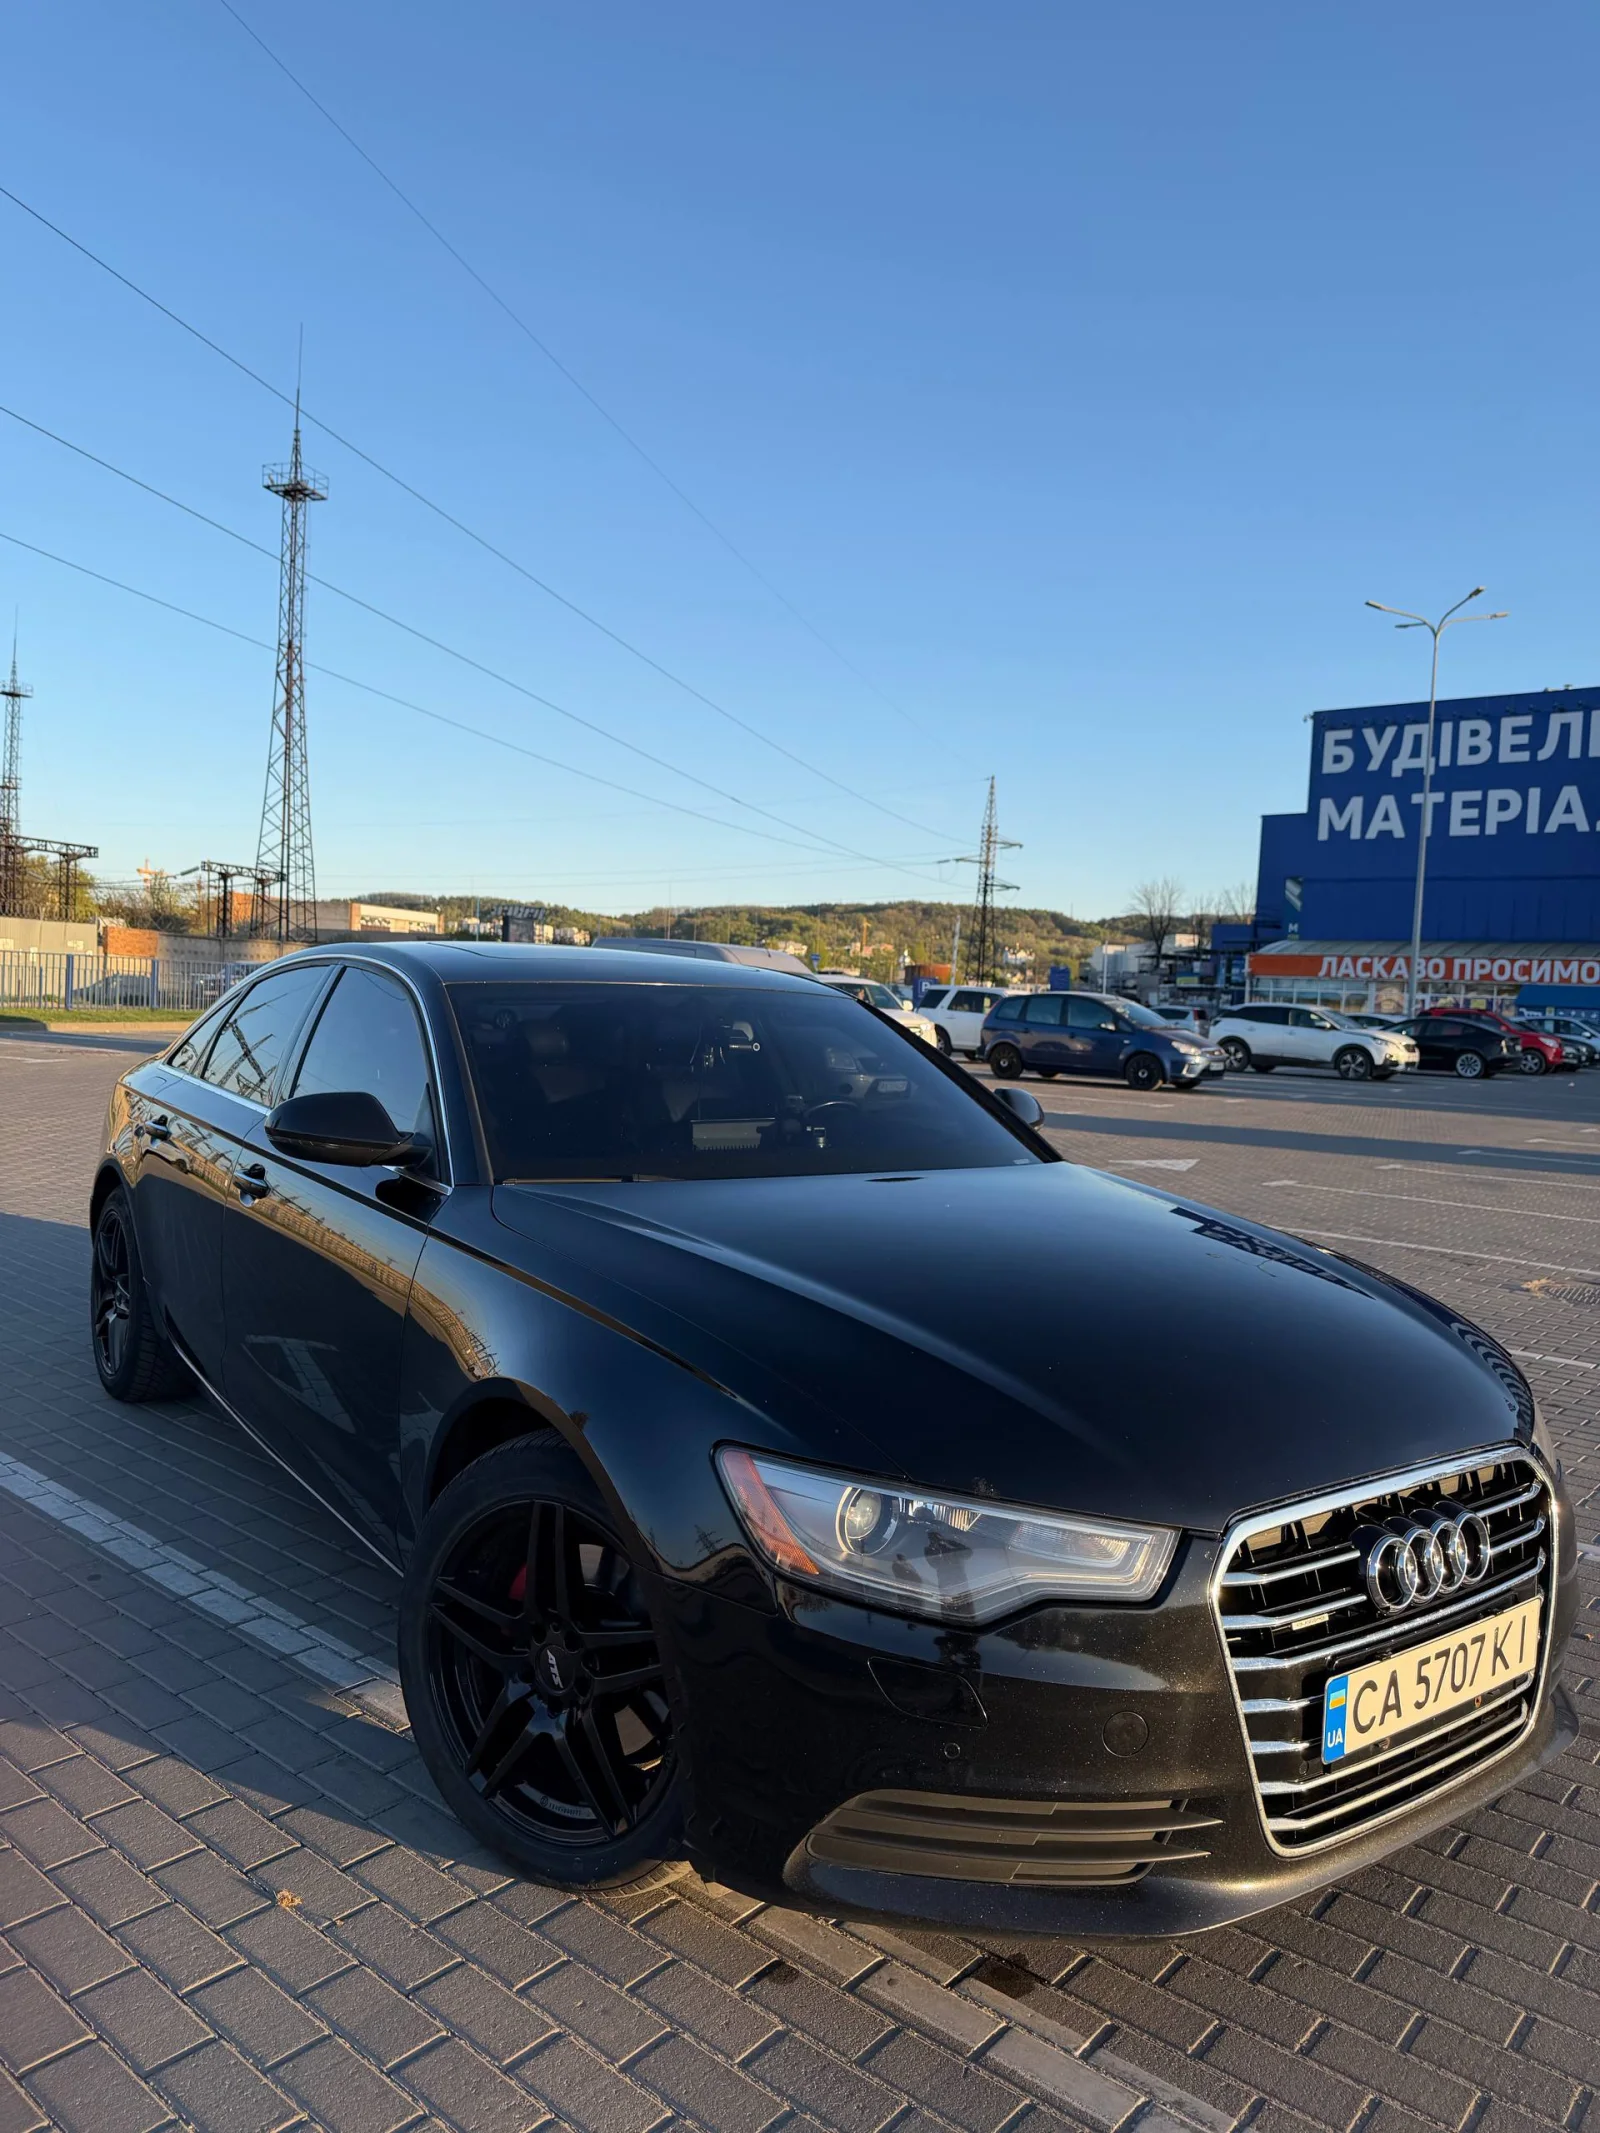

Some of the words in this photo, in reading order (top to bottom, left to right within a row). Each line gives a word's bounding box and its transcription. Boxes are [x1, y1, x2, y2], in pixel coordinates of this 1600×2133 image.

[1321, 708, 1600, 778] БУДІВЕЛ
[1317, 785, 1600, 841] МАТЕРІА
[1453, 957, 1600, 984] ПРОСИМО
[1352, 1669, 1402, 1735] CA
[1413, 1632, 1486, 1710] 5707
[1491, 1615, 1527, 1677] KI
[1326, 1727, 1344, 1749] UA
